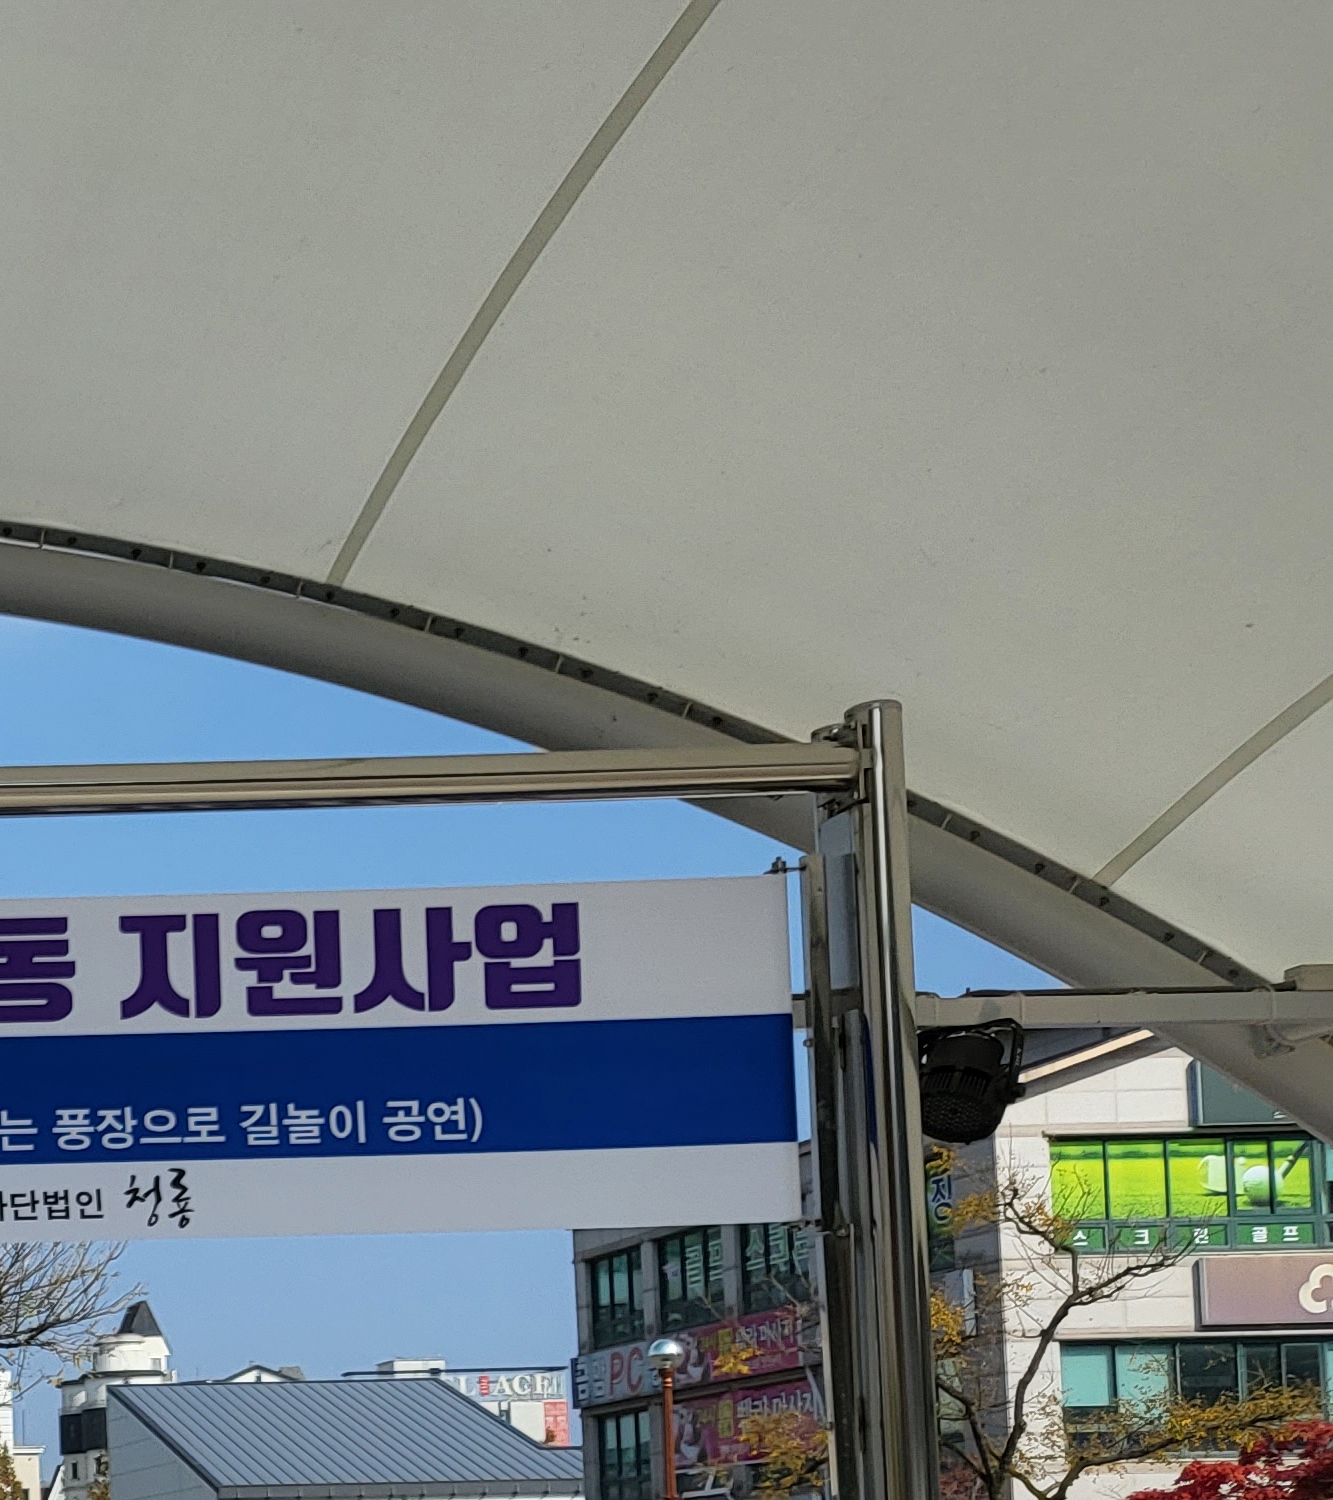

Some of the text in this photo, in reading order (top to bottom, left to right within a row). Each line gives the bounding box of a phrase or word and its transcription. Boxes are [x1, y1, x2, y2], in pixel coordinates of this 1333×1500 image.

[118, 902, 583, 1019] 지원사업
[51, 1105, 227, 1151] 풍장으로
[238, 1100, 368, 1148] 길놀이
[382, 1097, 483, 1144] 공연)
[123, 1167, 196, 1228] 청룡
